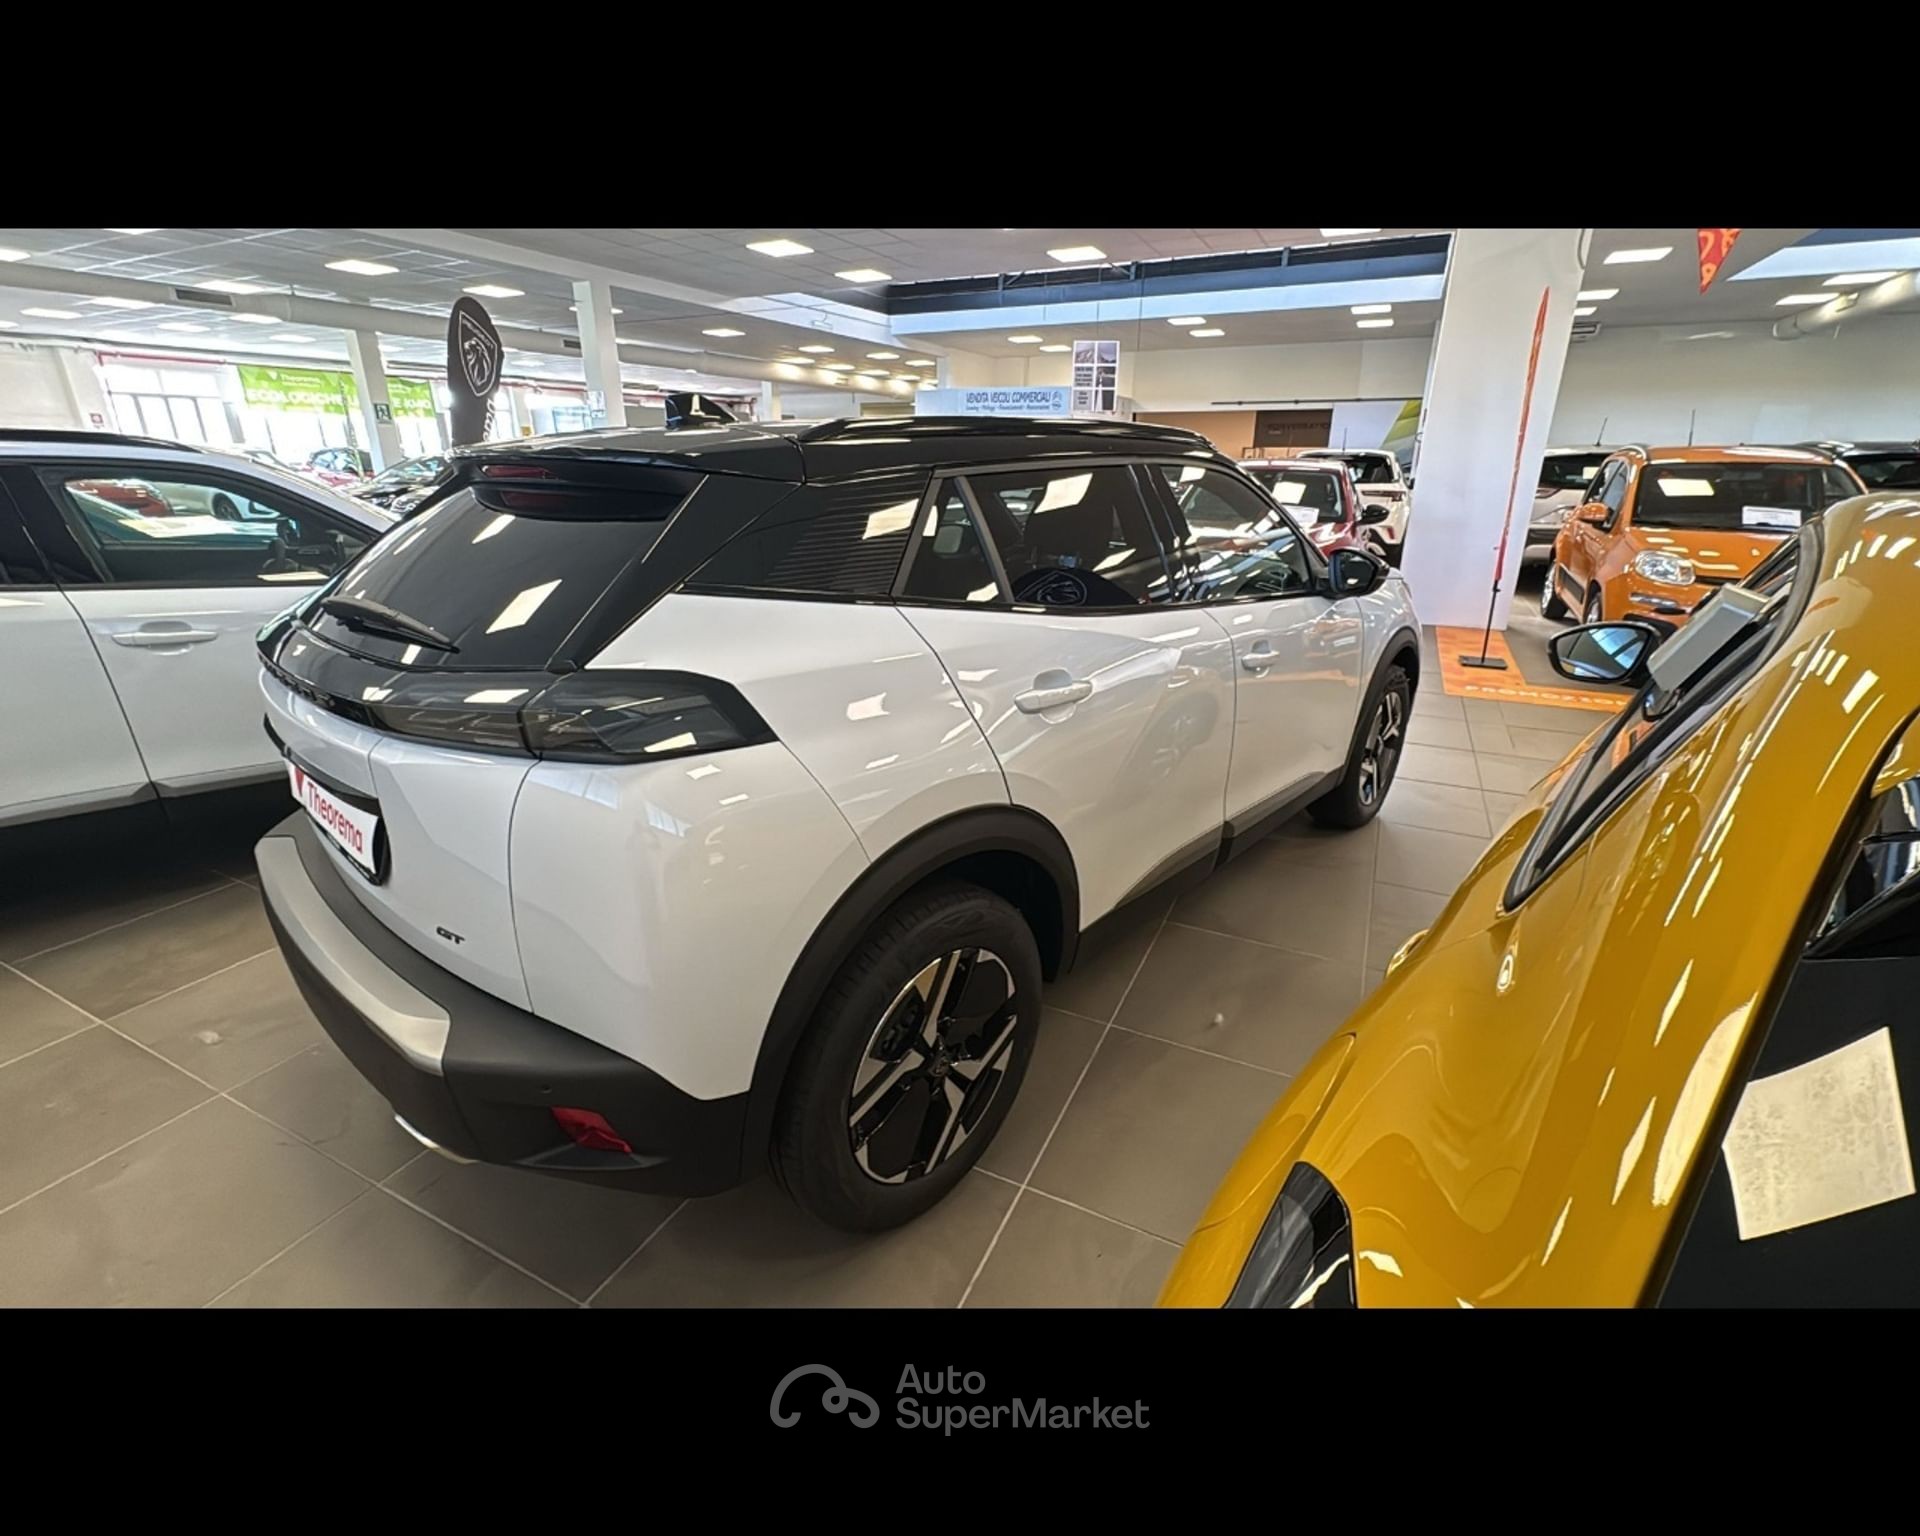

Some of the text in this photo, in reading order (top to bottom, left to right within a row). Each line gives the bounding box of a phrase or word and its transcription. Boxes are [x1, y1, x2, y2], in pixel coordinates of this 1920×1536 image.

[1465, 685, 1628, 706] PROMOZION
[307, 780, 363, 855] Theorema
[436, 926, 465, 944] GT
